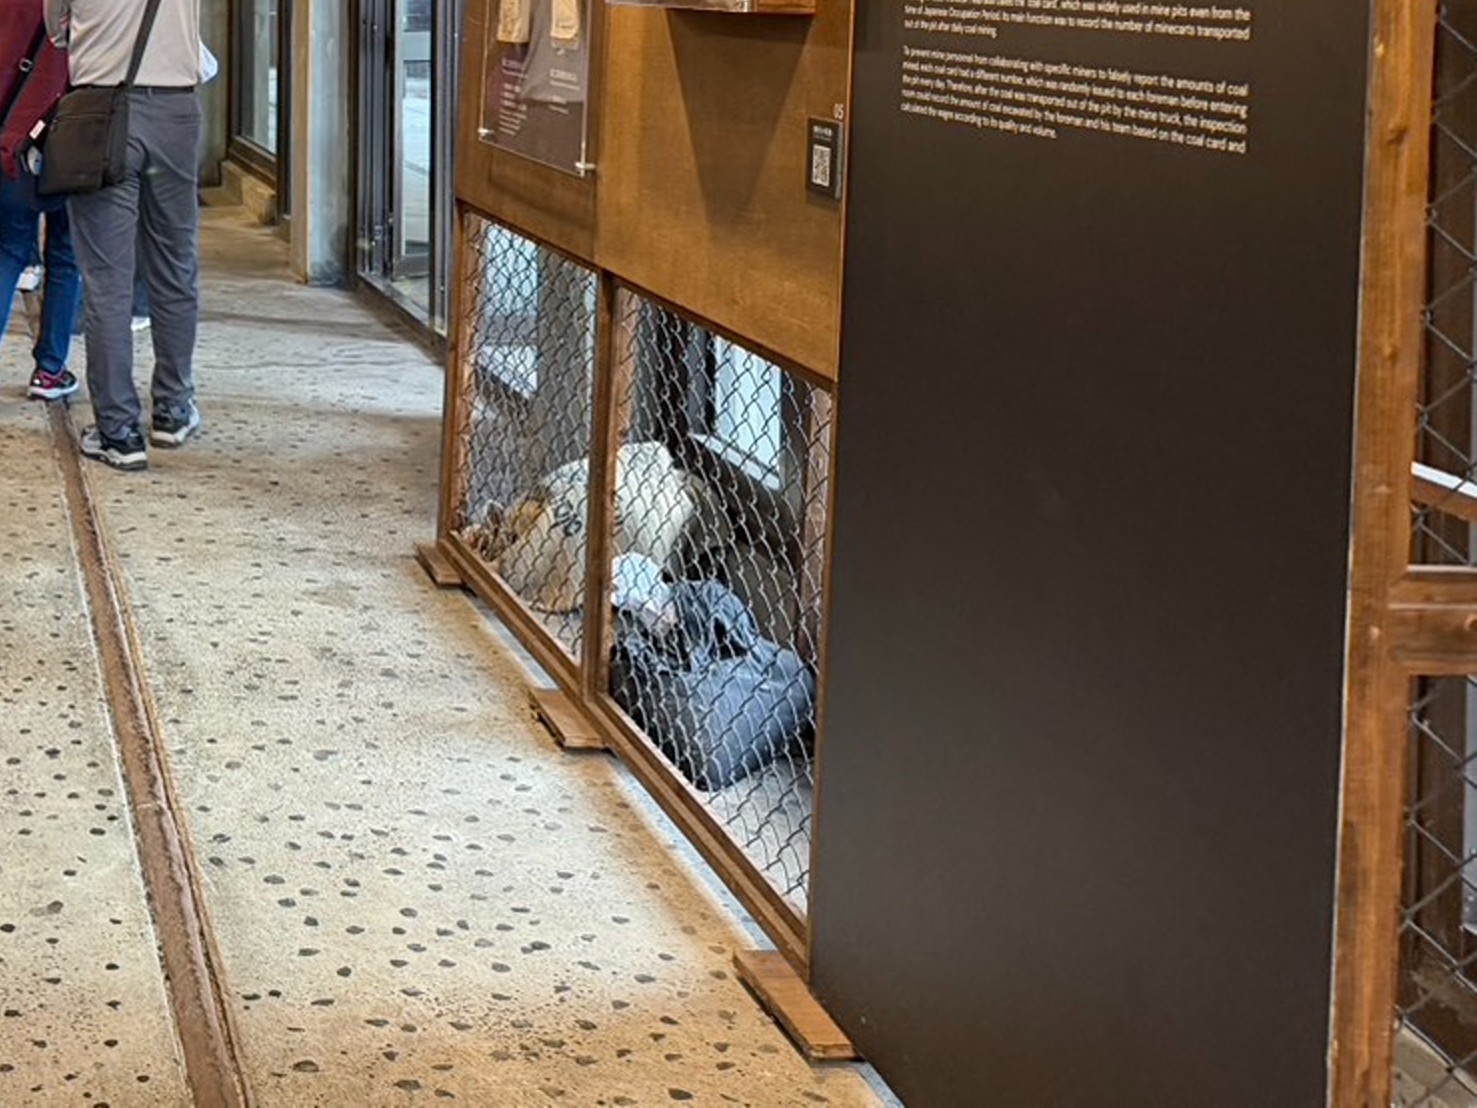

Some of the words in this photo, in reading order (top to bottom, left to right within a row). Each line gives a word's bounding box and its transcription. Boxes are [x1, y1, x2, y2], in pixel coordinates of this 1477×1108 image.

[1233, 6, 1251, 20] the
[1227, 82, 1248, 96] coal
[1209, 100, 1247, 118] entering
[1227, 139, 1246, 153] and
